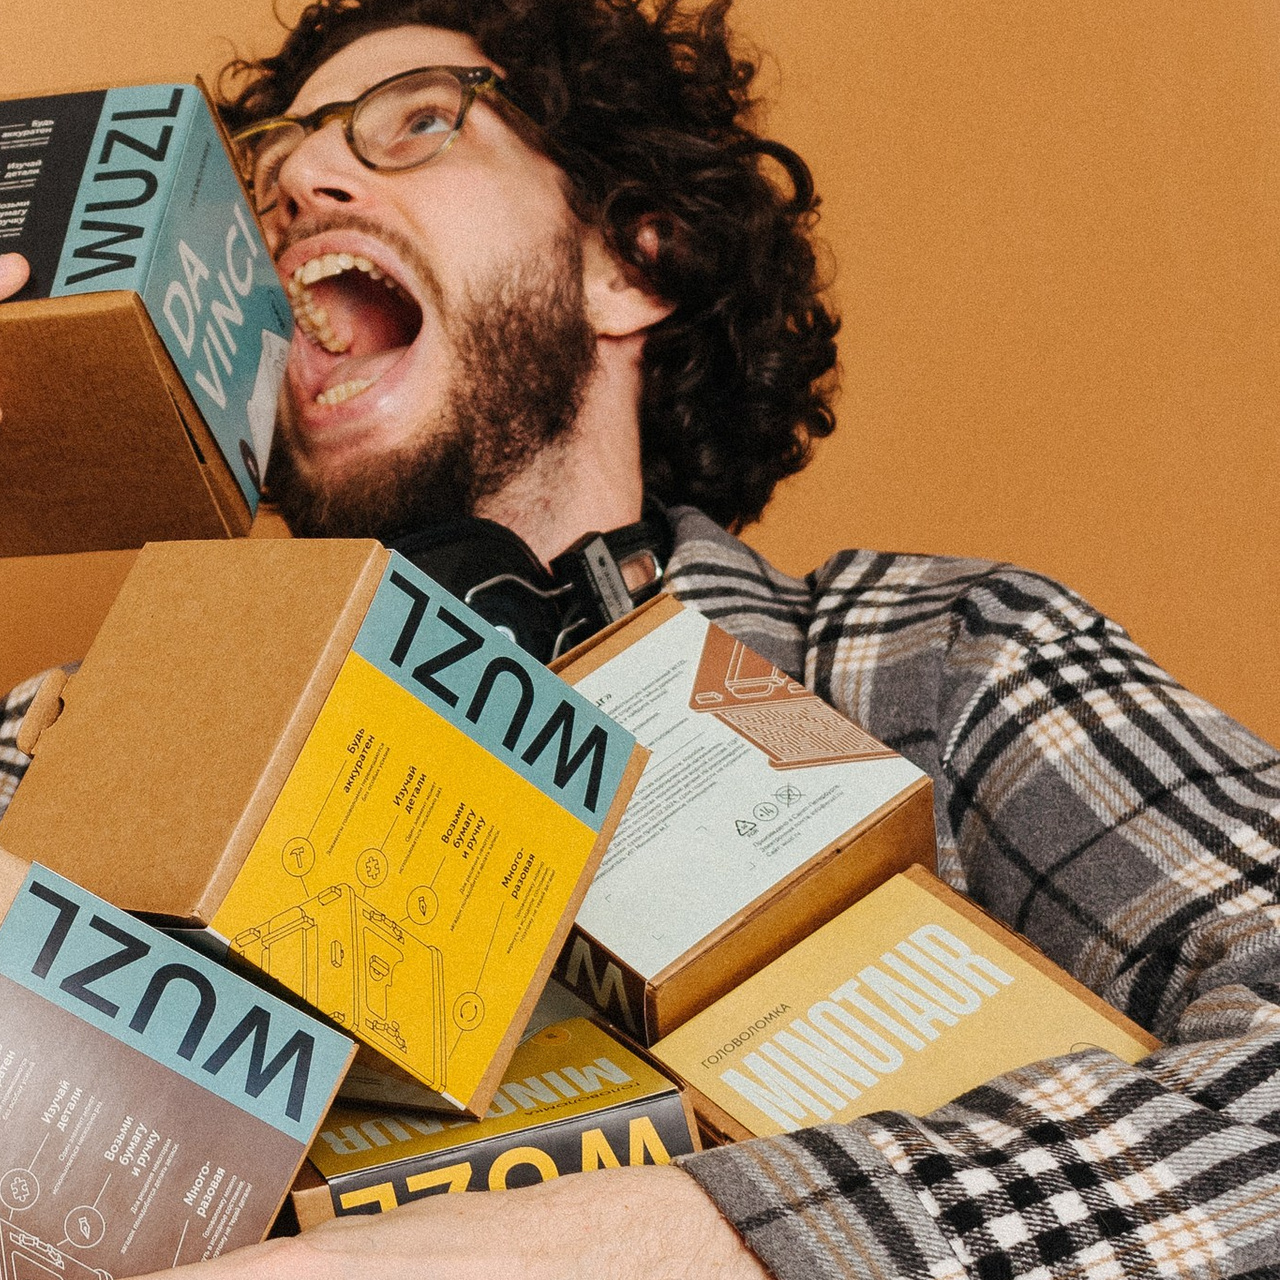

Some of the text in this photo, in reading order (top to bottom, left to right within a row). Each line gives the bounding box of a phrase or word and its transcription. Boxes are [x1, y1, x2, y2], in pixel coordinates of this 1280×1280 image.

[65, 87, 185, 286] WUZL
[163, 238, 210, 359] DA
[194, 202, 259, 410] VINCI
[388, 568, 611, 815] WUZL
[343, 734, 375, 793] аккуратен
[346, 728, 365, 754] Будь
[392, 765, 417, 806] Изучай
[404, 773, 427, 815] детали
[440, 802, 466, 844] Возьми
[452, 808, 476, 849] бумагу
[461, 816, 486, 859] и ручку
[501, 847, 524, 888] Много-
[511, 853, 535, 900] разовая
[27, 880, 316, 1123] WUZL
[700, 1003, 791, 1069] ГОЛОВОЛОМКА
[721, 921, 1016, 1133] MINOTAUR
[40, 1079, 70, 1124] Изучай
[56, 1087, 83, 1132] детали
[321, 1058, 632, 1155] MINOAUR
[524, 1080, 641, 1116] ГОЛОВОЛОМКА
[103, 1115, 134, 1161] Возьми
[119, 1122, 148, 1165] бумагу
[131, 1129, 160, 1177] и ручку
[183, 1160, 210, 1206] Много-
[196, 1166, 225, 1218] разовая
[212, 1234, 228, 1261] оэтому
